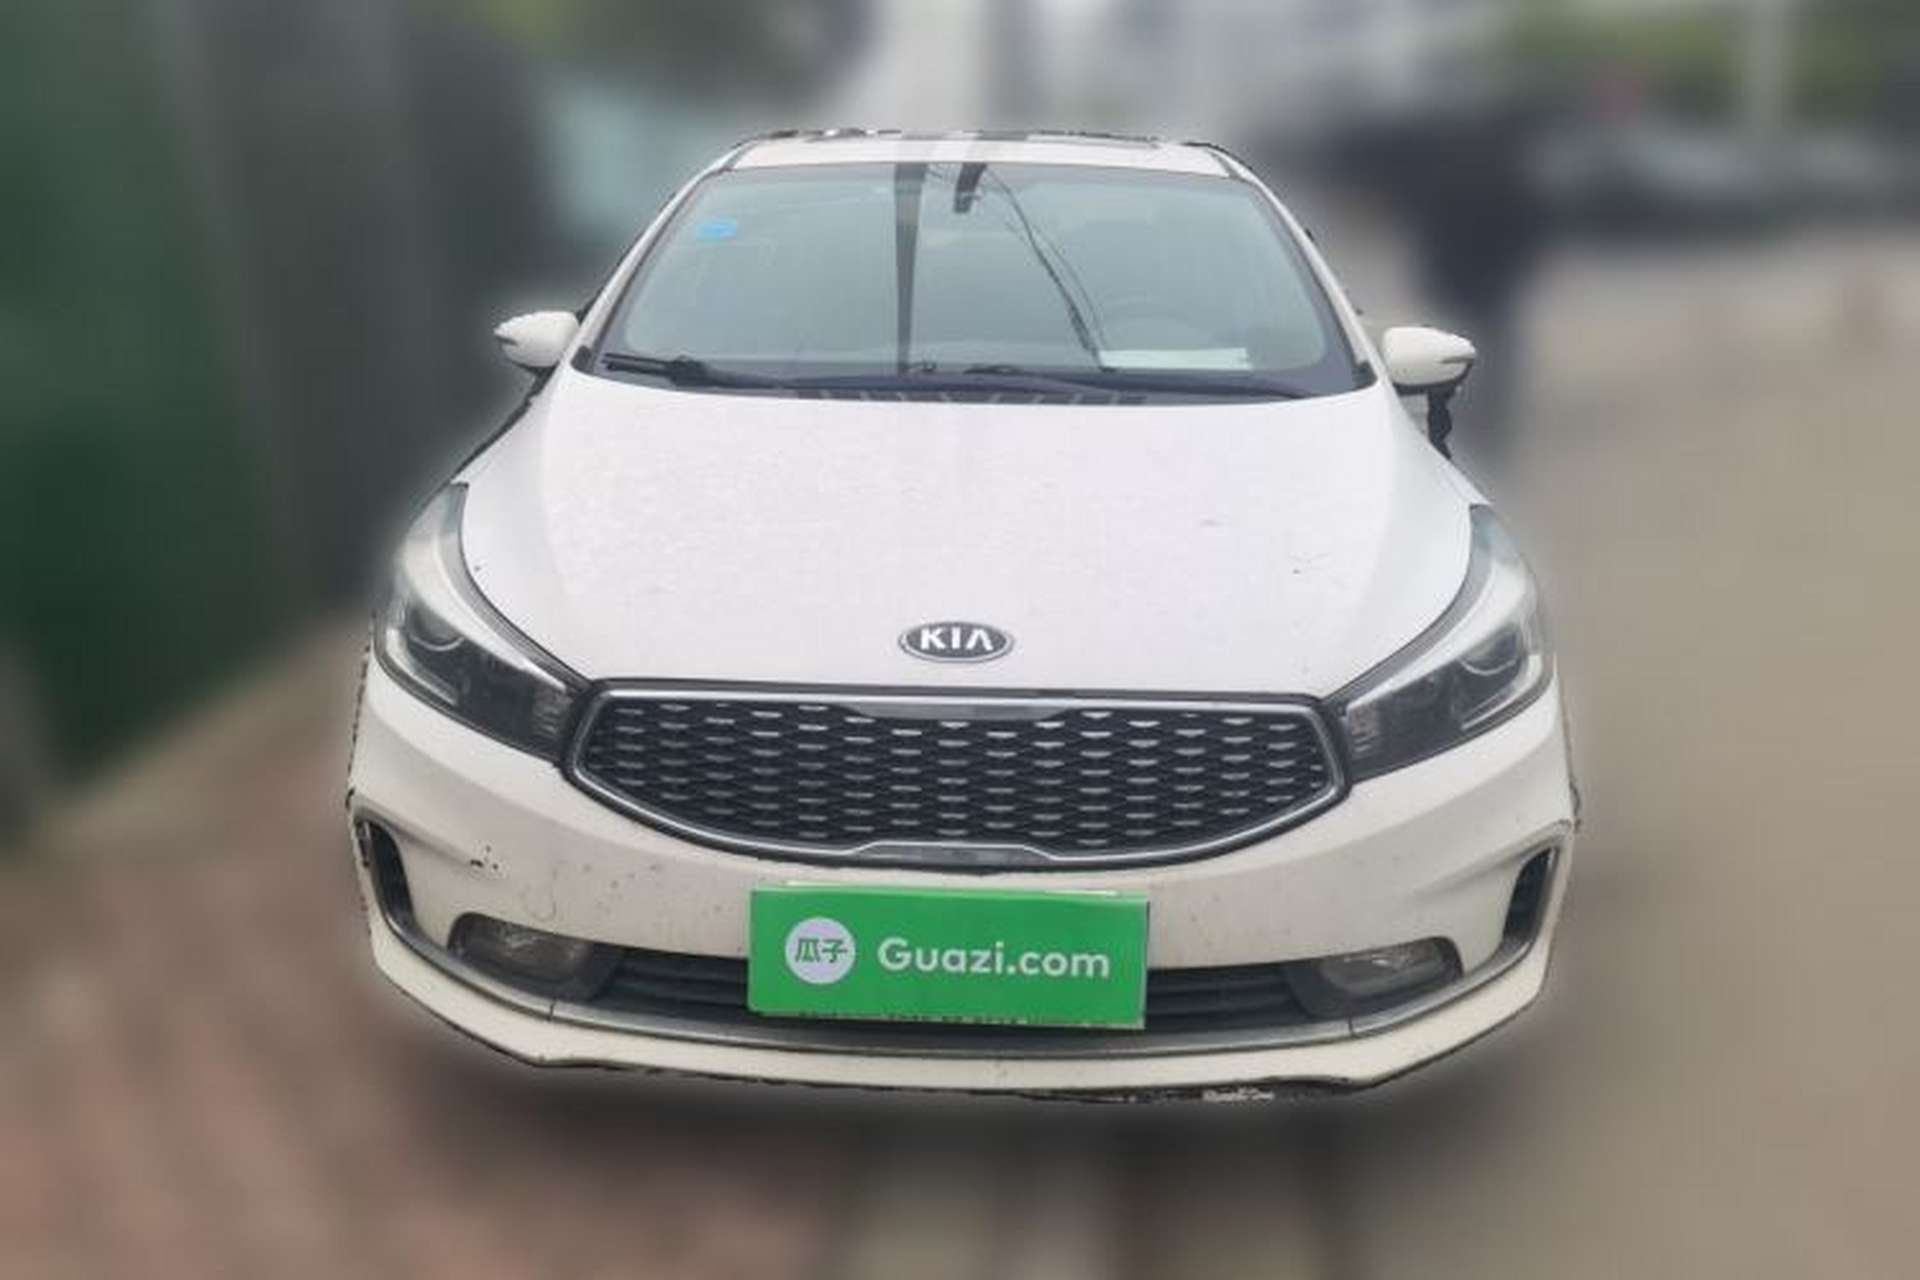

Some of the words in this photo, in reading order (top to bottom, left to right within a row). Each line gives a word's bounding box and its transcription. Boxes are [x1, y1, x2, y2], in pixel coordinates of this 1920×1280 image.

[921, 627, 994, 650] KIA
[795, 938, 848, 963] 瓜子
[877, 937, 1110, 978] Guazi.com
